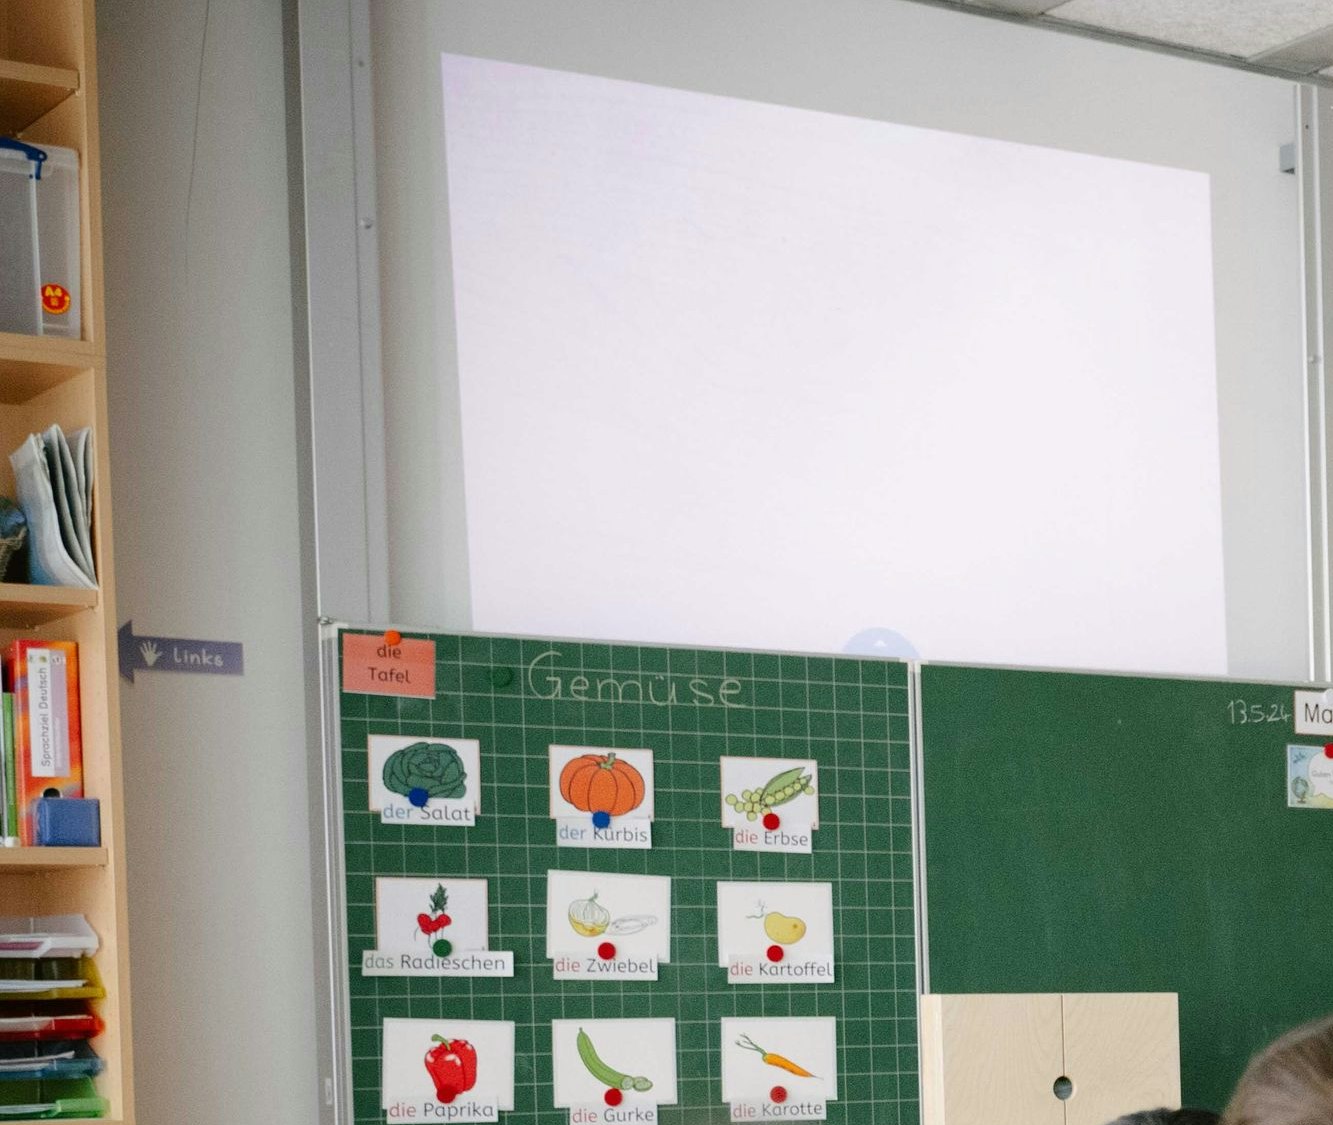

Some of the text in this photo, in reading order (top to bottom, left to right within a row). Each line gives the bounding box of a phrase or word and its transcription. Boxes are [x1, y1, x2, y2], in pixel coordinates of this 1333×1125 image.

[172, 647, 224, 666] links
[376, 645, 401, 660] die
[367, 666, 411, 685] Tafel
[528, 651, 749, 709] Gemüse
[39, 667, 48, 709] Deutsch
[1227, 700, 1291, 724] 13.5.24
[383, 803, 472, 822] der Salat
[559, 825, 648, 843] der Kürbis
[735, 830, 809, 847] die Erbse
[365, 955, 506, 971] das Radieschen
[555, 957, 656, 974] die Zwiebel
[730, 962, 833, 977] die Kartoffel
[389, 1102, 494, 1120] die Paprika
[573, 1107, 654, 1123] die Gurke
[733, 1103, 823, 1118] die Karotte
